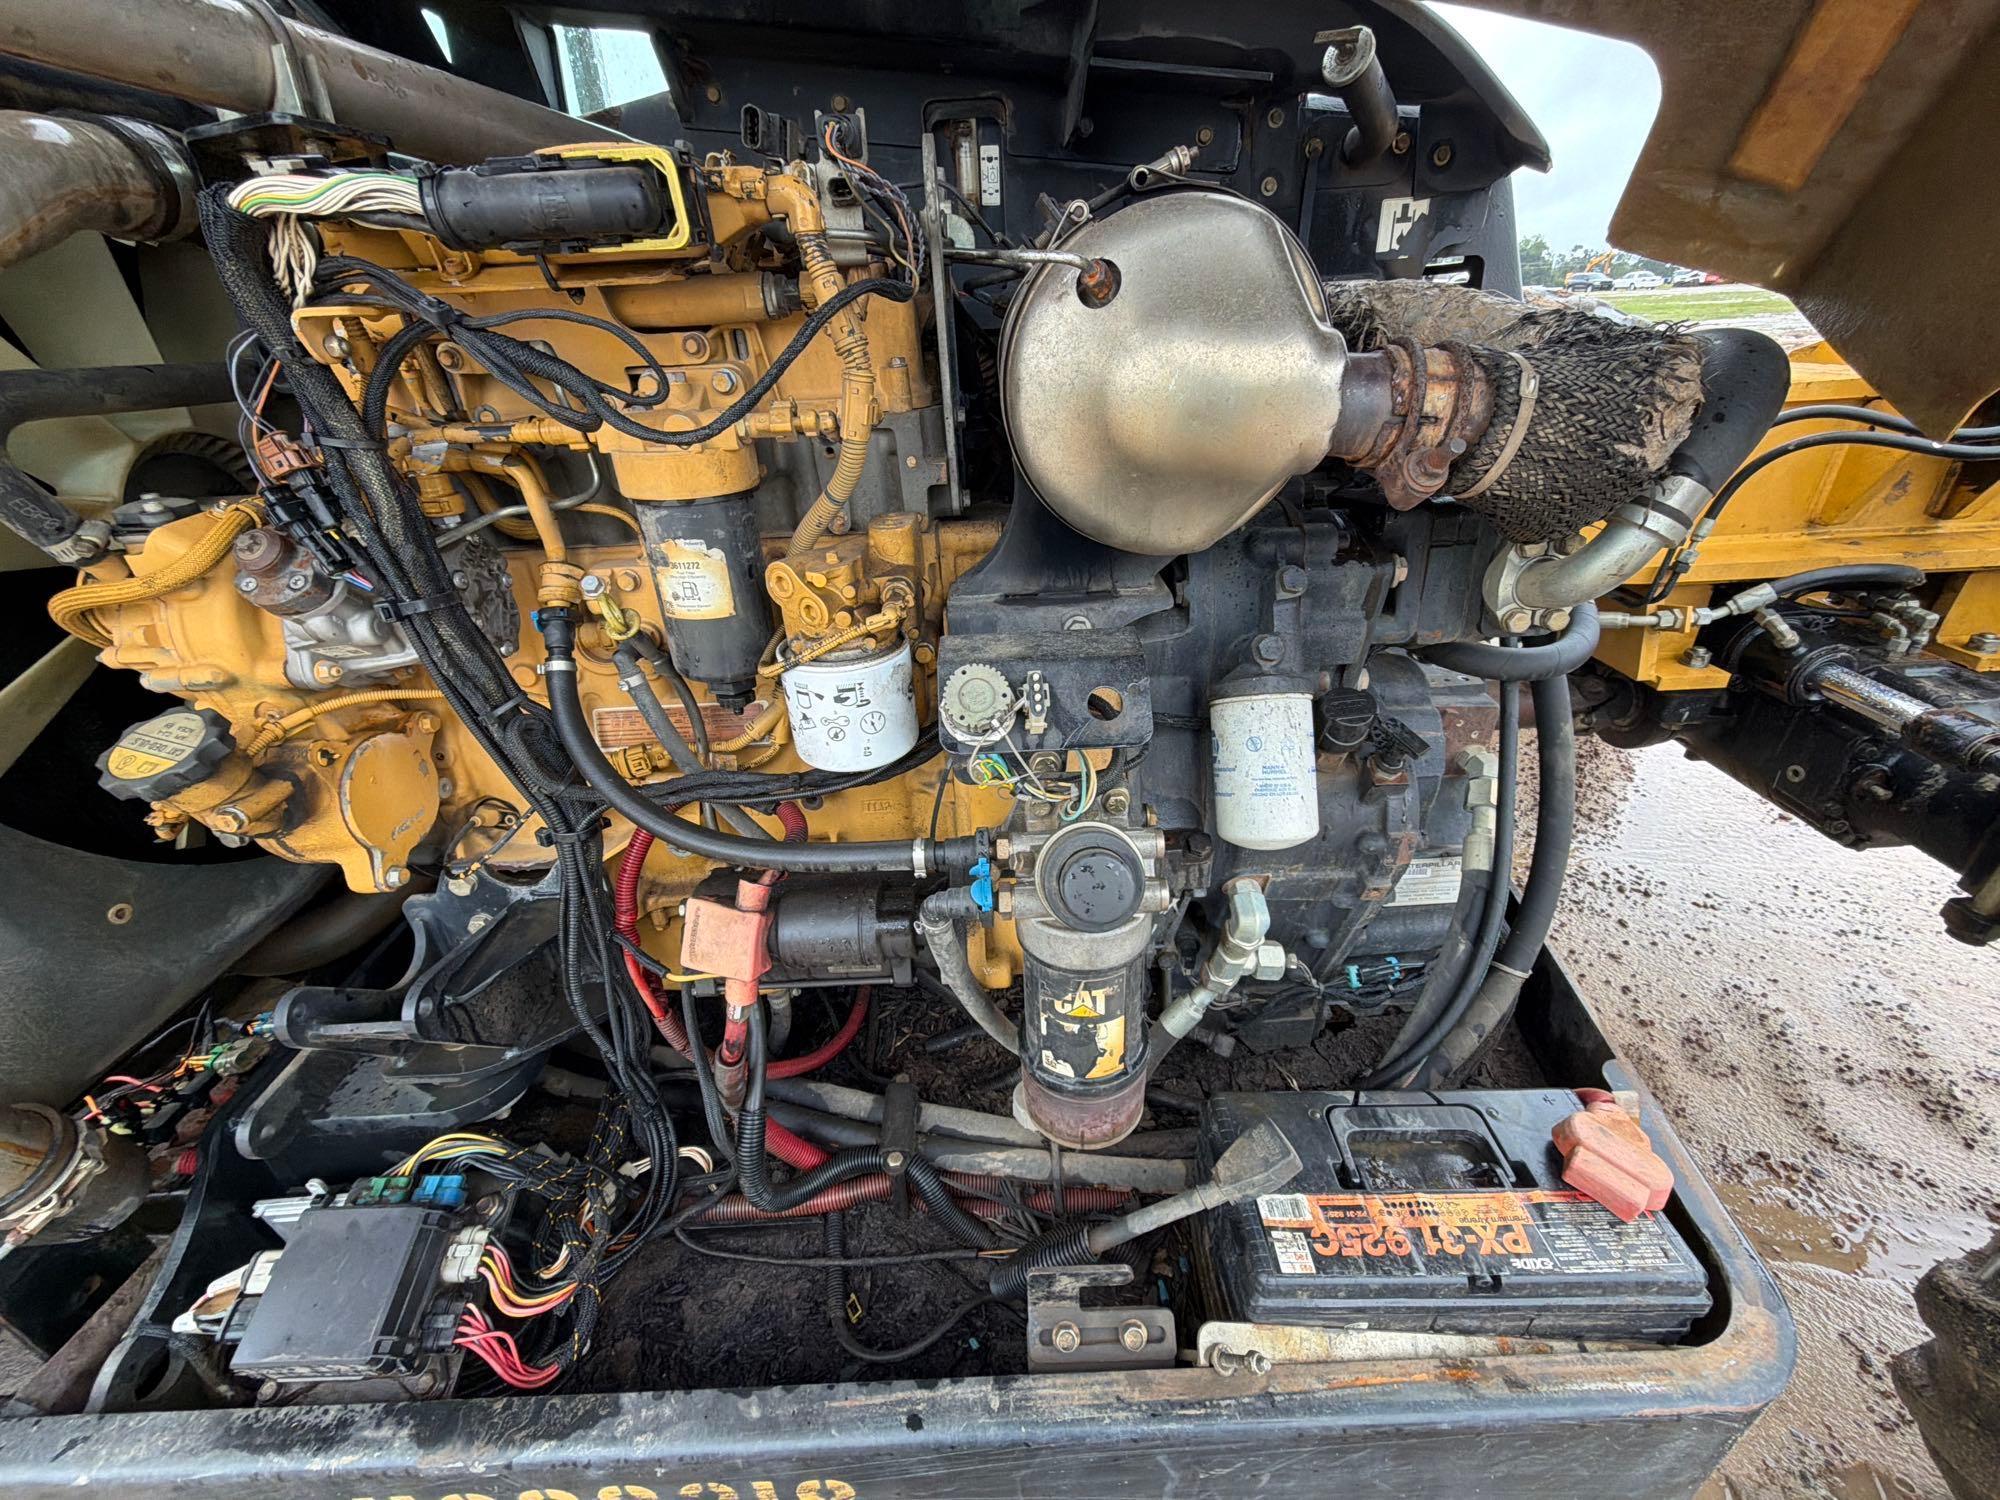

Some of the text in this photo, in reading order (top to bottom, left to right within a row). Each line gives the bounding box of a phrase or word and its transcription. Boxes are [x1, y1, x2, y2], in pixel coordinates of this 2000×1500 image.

[669, 561, 701, 570] 3611272
[1410, 860, 1461, 869] TERPILLAR
[1054, 989, 1105, 1015] CAT
[1491, 1215, 1530, 1224] Premium
[1311, 1224, 1412, 1257] 925C
[1420, 1224, 1533, 1256] PX-31
[1510, 1257, 1553, 1270] EXIDE
